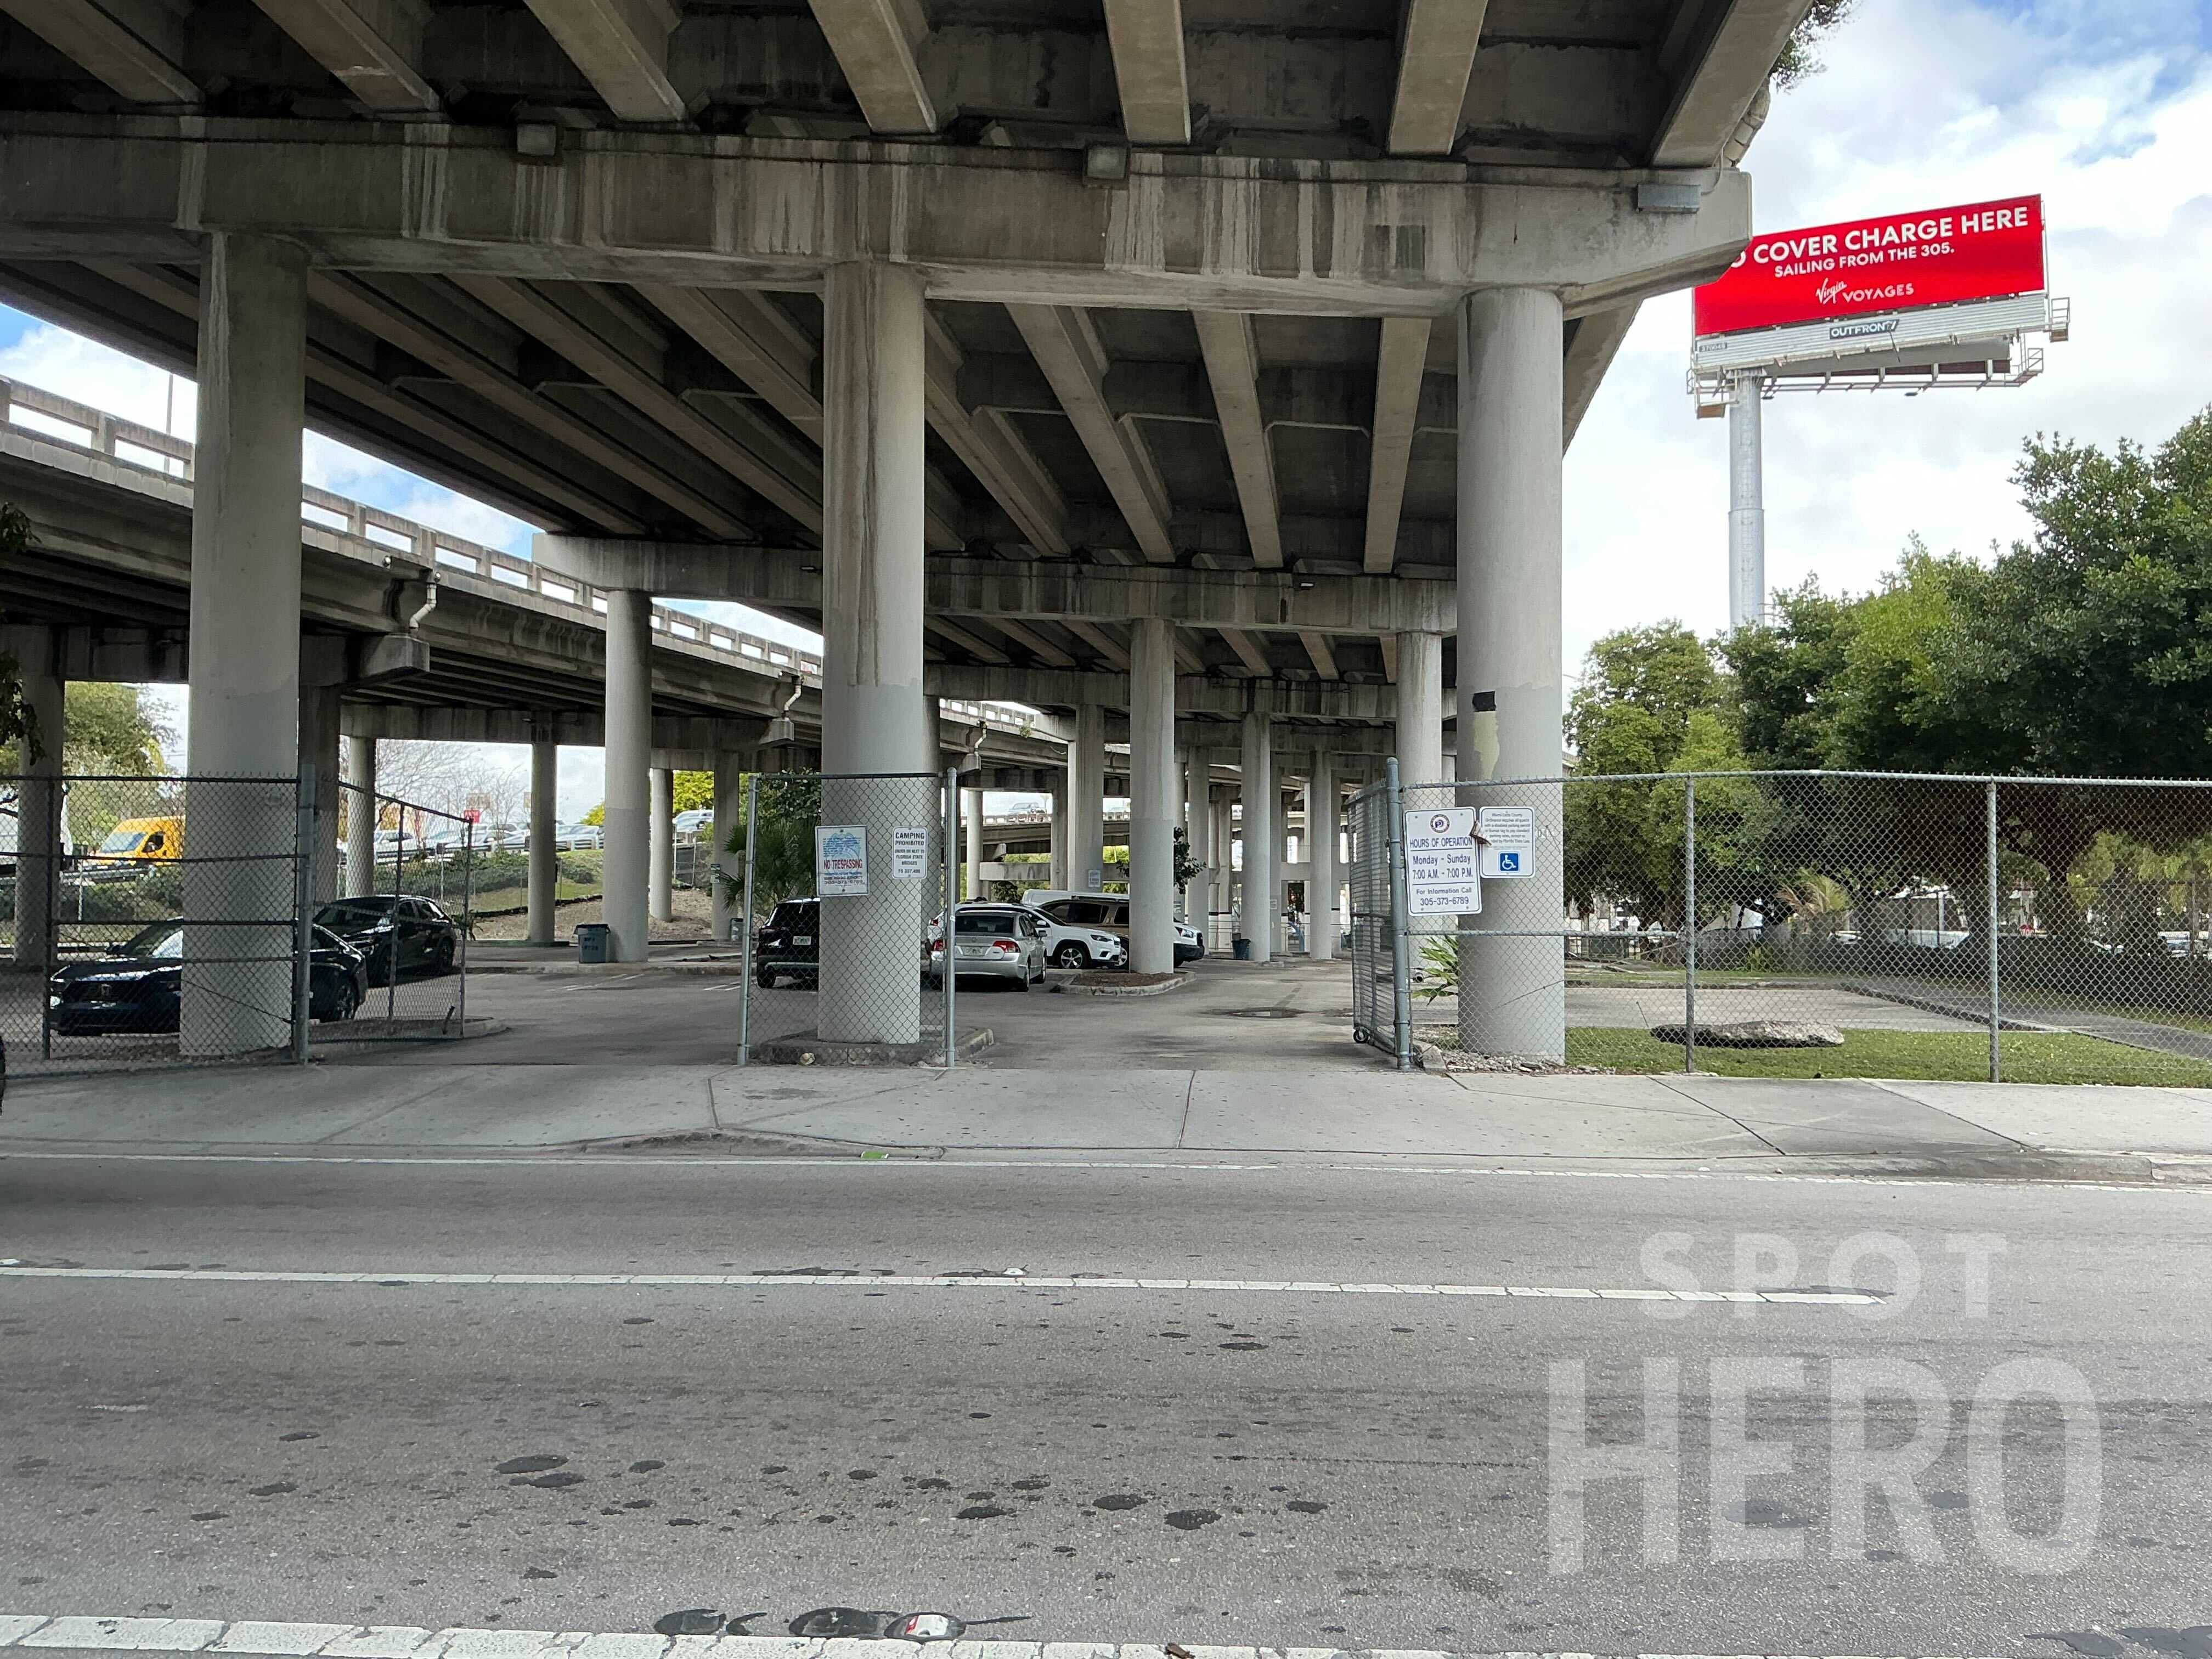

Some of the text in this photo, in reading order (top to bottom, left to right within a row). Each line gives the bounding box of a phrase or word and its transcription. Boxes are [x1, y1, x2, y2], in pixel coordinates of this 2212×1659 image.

[1753, 234, 1838, 263] COVER
[1844, 217, 1953, 250] CHARGE
[1961, 206, 2028, 234] HERE
[1774, 241, 1955, 278] SAILING FROM THE 305.
[1815, 278, 1914, 305] Virgin VOYAGES
[1409, 837, 1472, 848] HOURS OF OPERATION
[823, 859, 863, 870] NO TRESPASSING
[1413, 855, 1438, 866] Monday
[1447, 854, 1471, 865] Sunday
[1413, 870, 1425, 879] 7:00
[1427, 869, 1440, 879] A.M.
[1447, 868, 1459, 878] 7:00
[1462, 867, 1474, 877] P.M.
[1420, 896, 1469, 906] 305-373-6789
